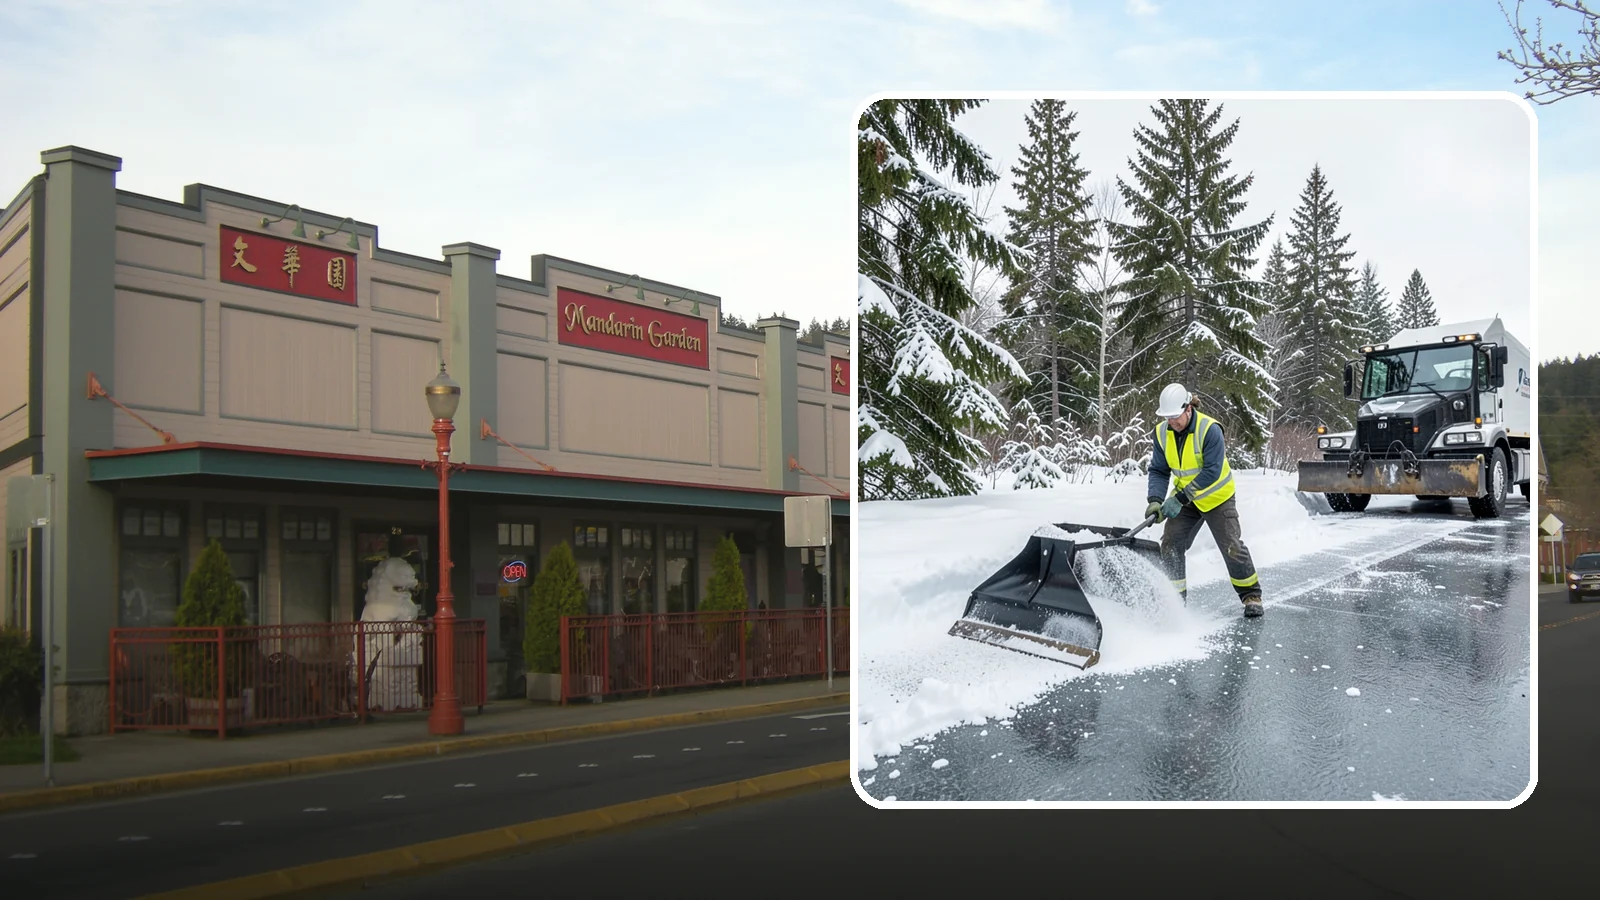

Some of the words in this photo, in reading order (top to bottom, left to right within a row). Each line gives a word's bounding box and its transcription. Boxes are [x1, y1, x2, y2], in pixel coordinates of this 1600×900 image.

[230, 235, 346, 291] 文華園
[564, 302, 644, 341] Mandarin
[647, 320, 702, 352] Garden
[503, 565, 527, 578] OPEN
